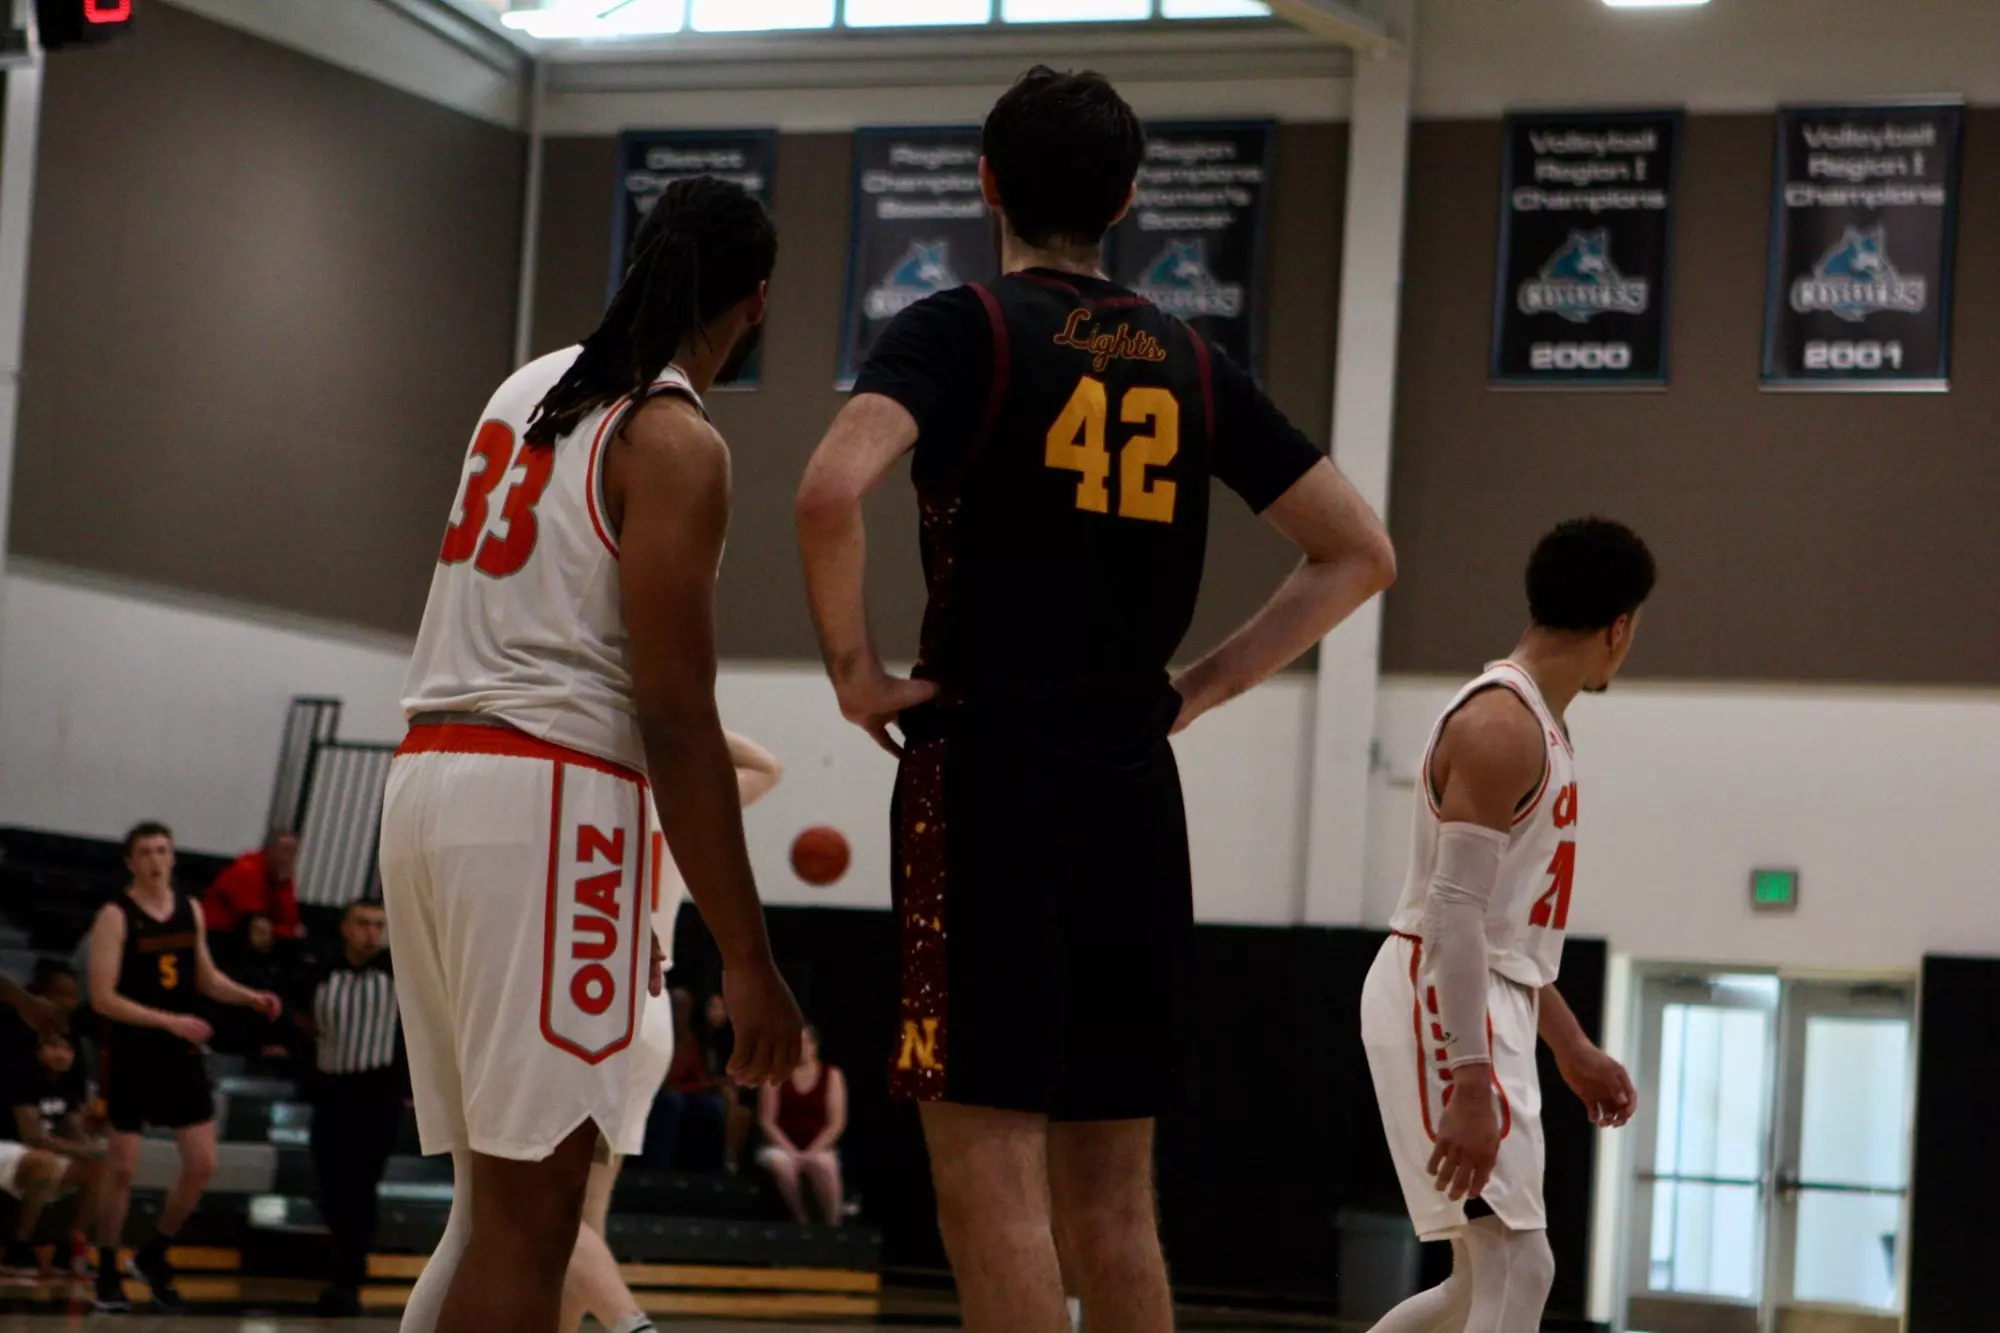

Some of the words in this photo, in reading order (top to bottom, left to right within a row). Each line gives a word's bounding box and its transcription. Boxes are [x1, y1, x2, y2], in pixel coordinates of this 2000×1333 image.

[1529, 130, 1658, 157] Volleyball
[1803, 123, 1936, 149] Volleyball
[1512, 187, 1667, 214] Champions
[1785, 183, 1944, 211] Champions
[1053, 308, 1166, 372] Lights
[1804, 340, 1903, 369] 2001
[1529, 341, 1631, 370] 2000
[1044, 375, 1180, 524] 42
[439, 419, 554, 580] 33
[570, 824, 624, 1016] OUAZ
[898, 1018, 941, 1069] N
